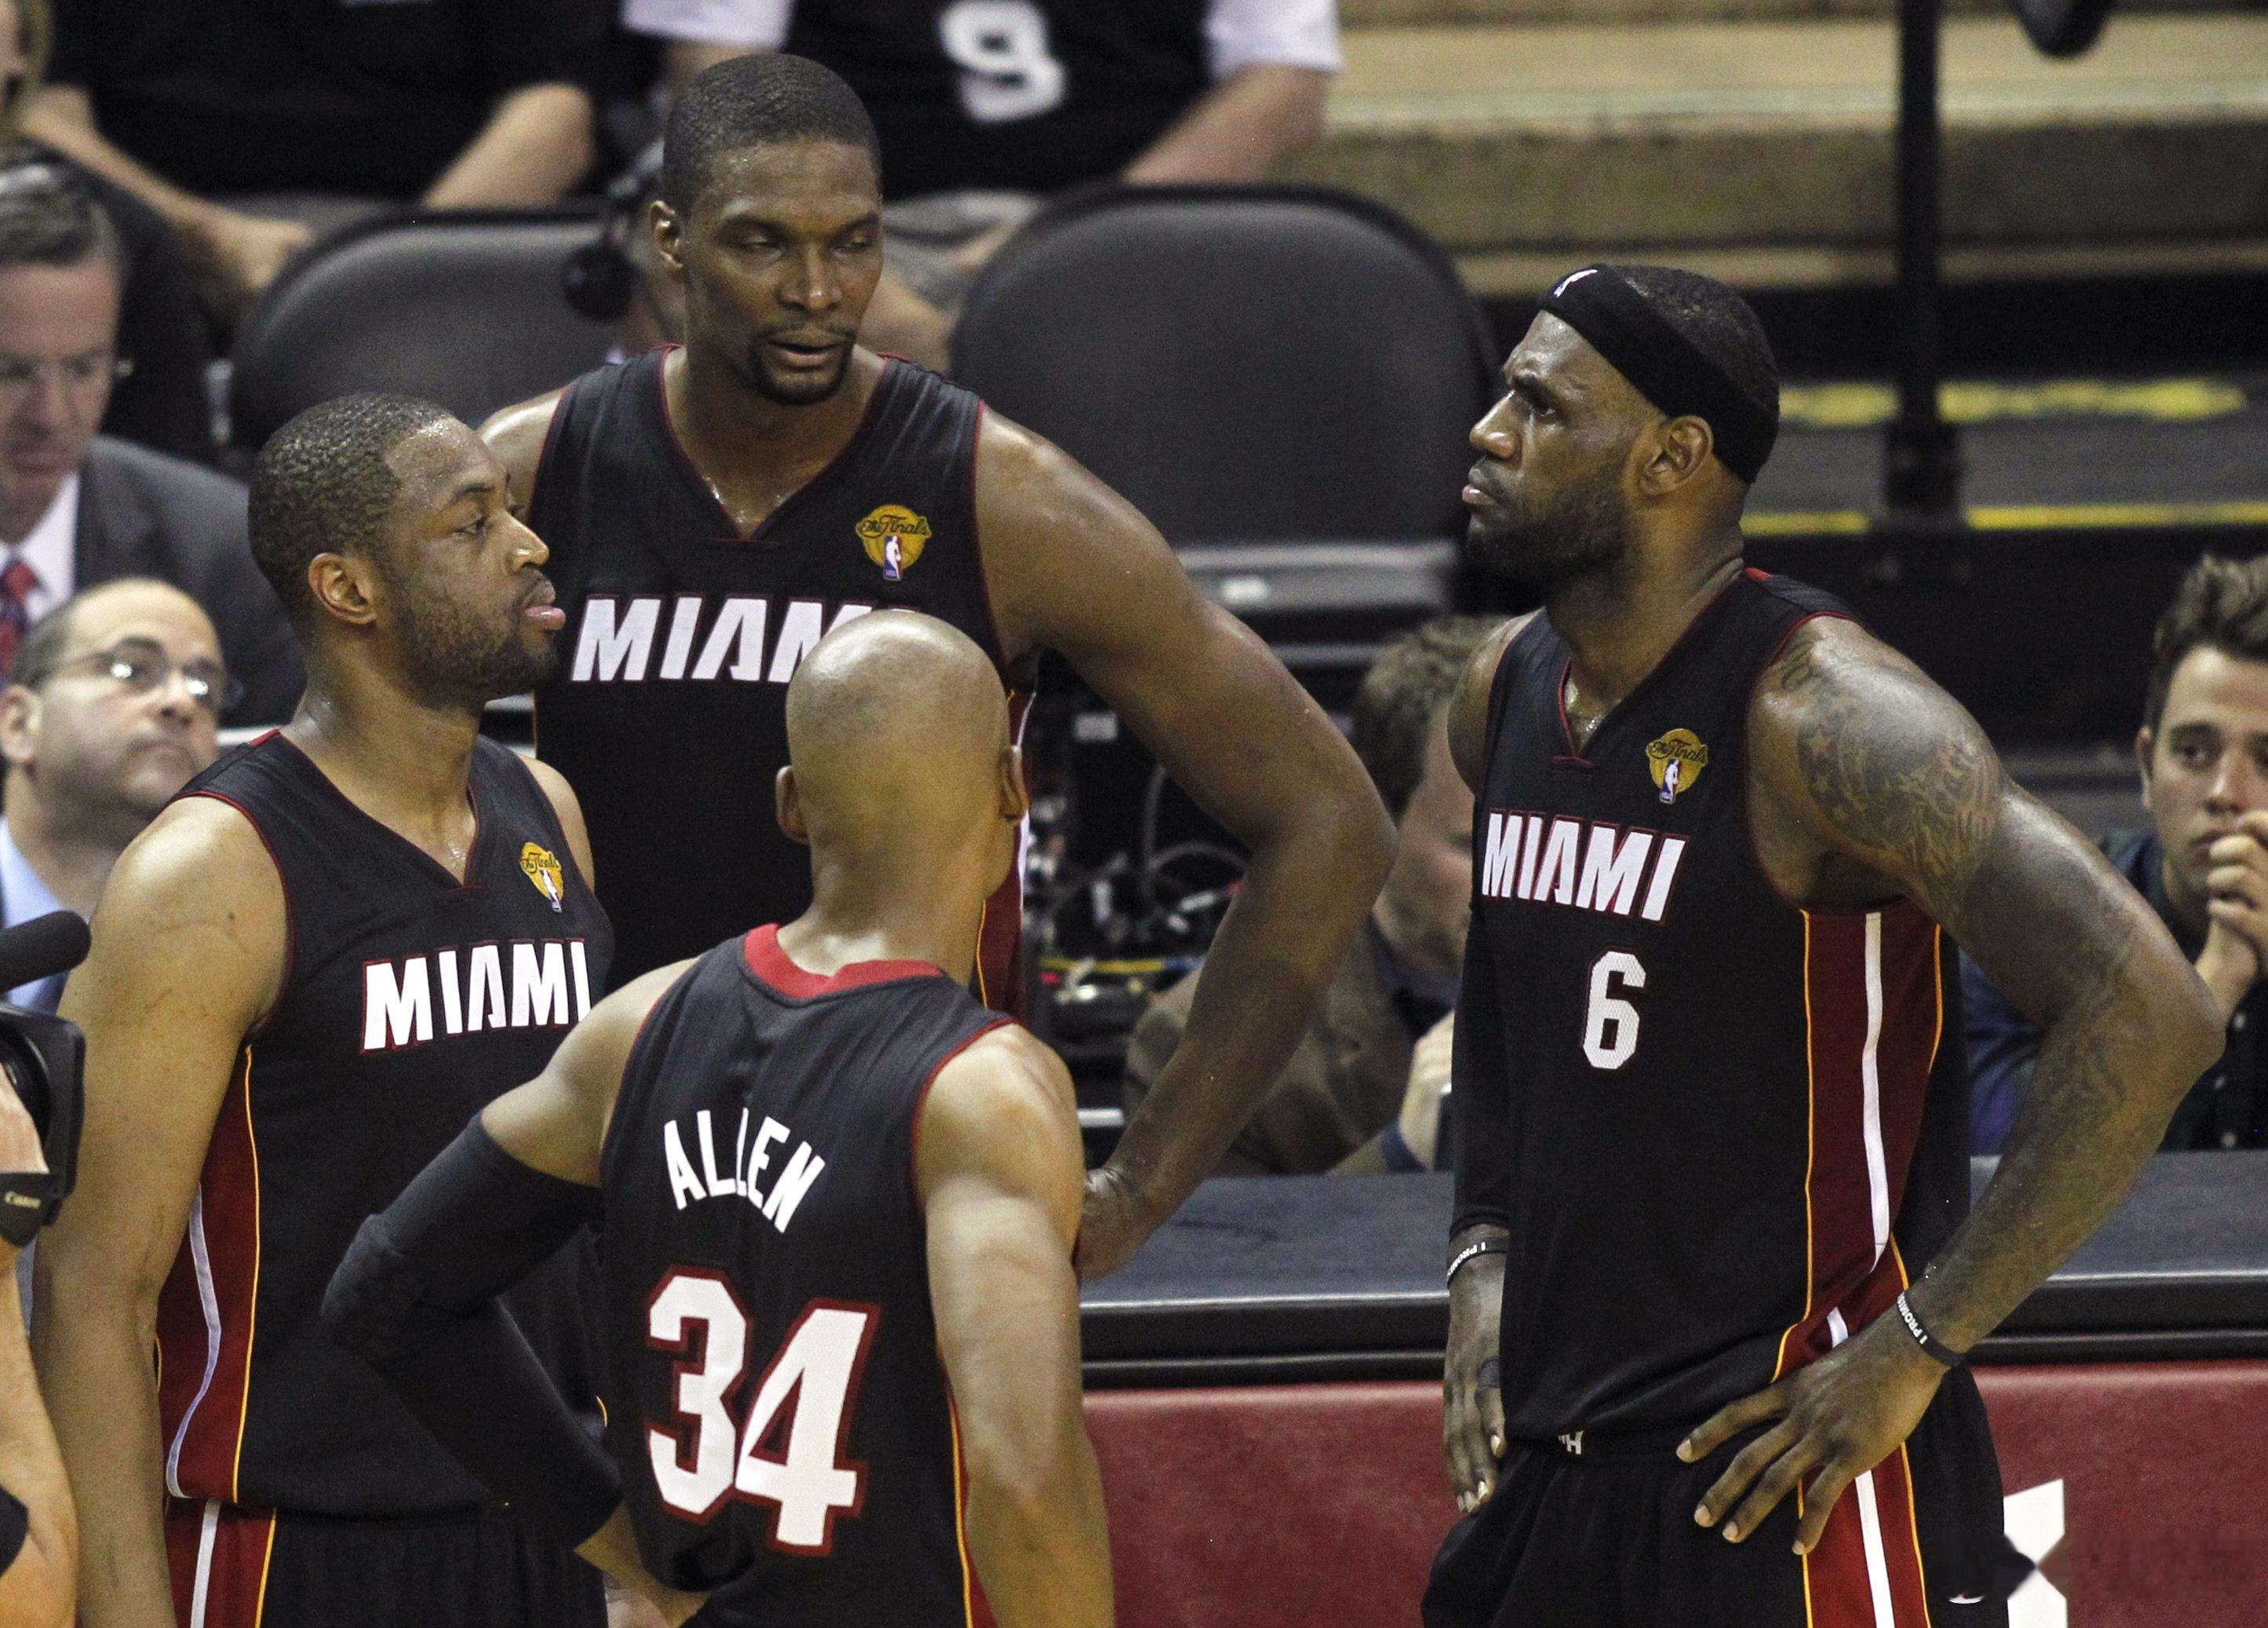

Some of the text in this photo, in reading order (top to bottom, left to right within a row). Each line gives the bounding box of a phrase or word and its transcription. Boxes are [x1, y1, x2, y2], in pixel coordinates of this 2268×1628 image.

[940, 2, 1065, 120] 9
[571, 597, 917, 683] MIAM
[1481, 811, 1688, 922] MIAMI
[363, 940, 592, 1051] MIAMI
[1581, 948, 1648, 1070] 6
[663, 1107, 826, 1234] ALLEN
[647, 1270, 873, 1551] 34
